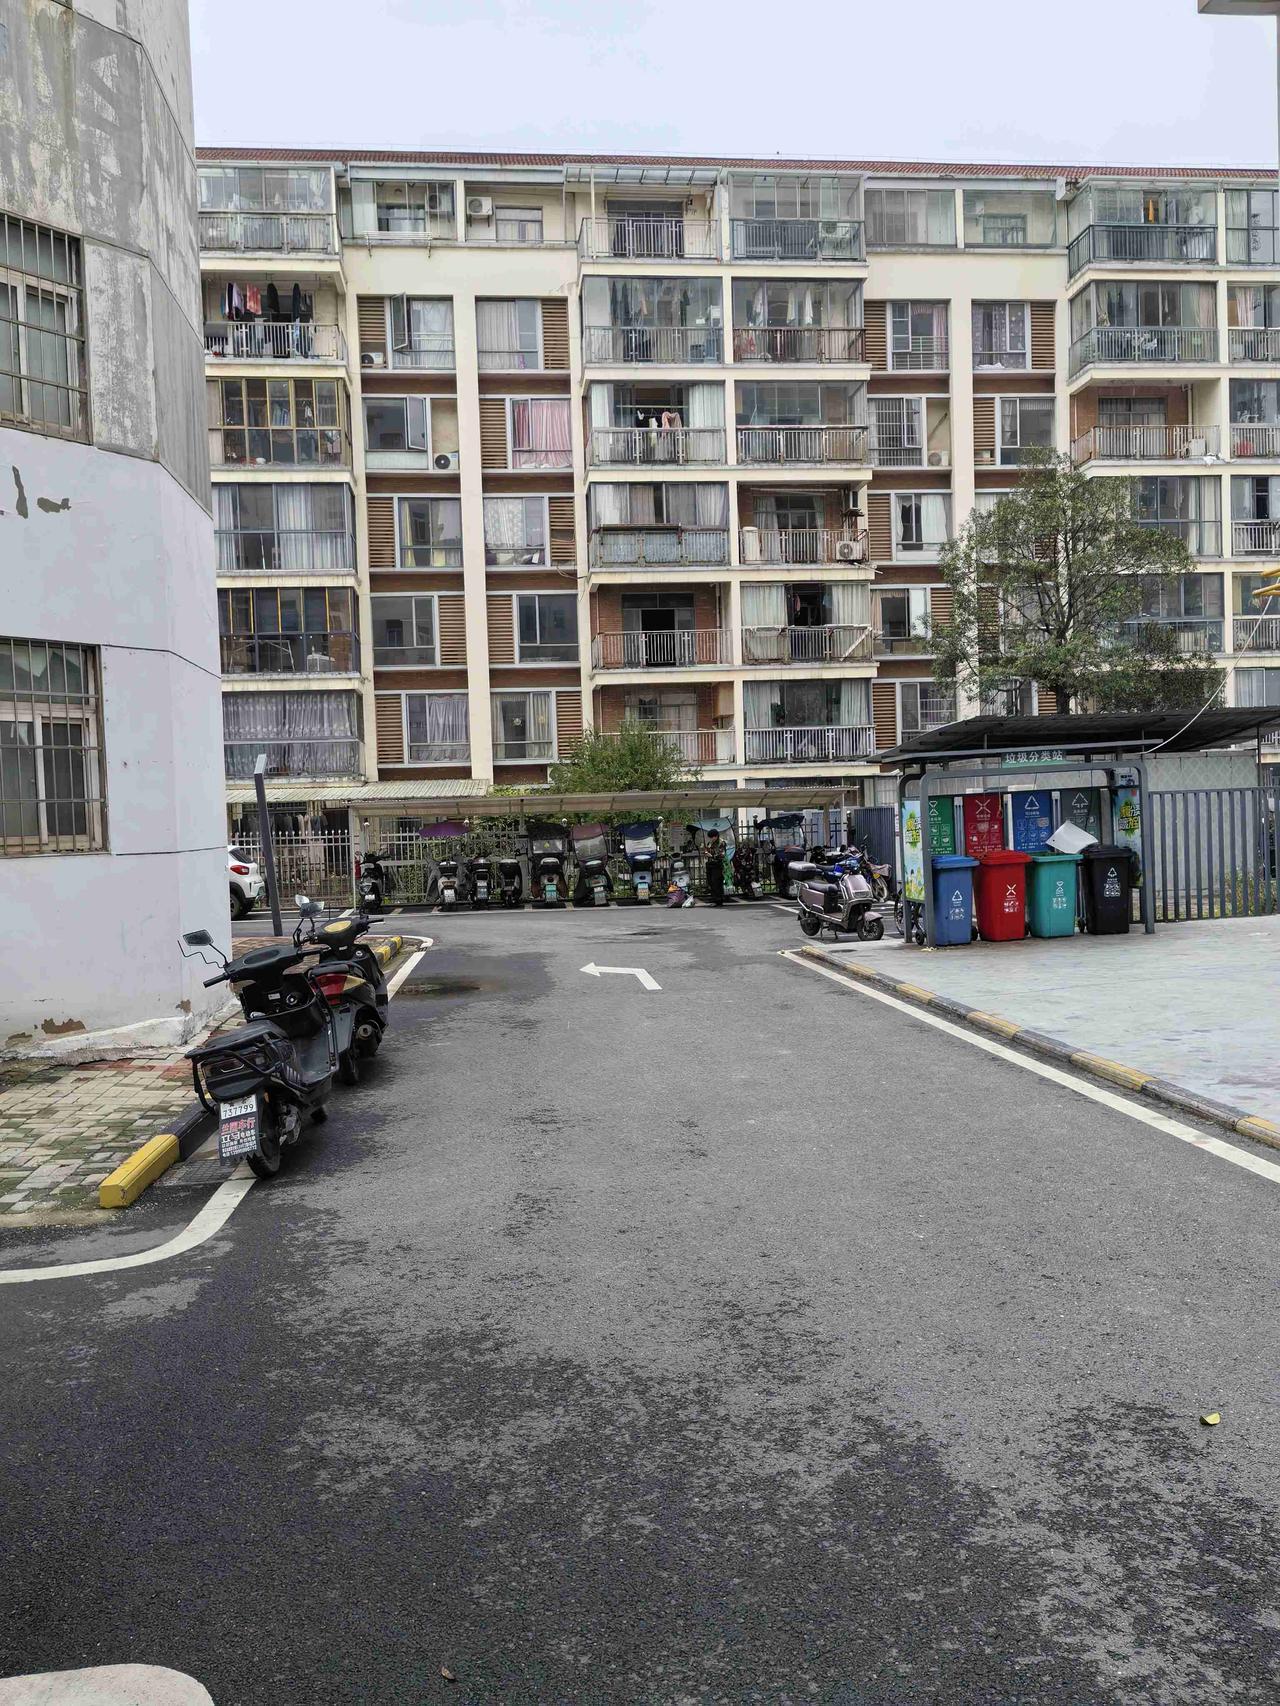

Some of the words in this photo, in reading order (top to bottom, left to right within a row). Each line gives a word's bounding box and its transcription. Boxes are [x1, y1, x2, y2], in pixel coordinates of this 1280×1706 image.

[1005, 750, 1063, 764] 垃圾分类站
[223, 1104, 254, 1118] 737799
